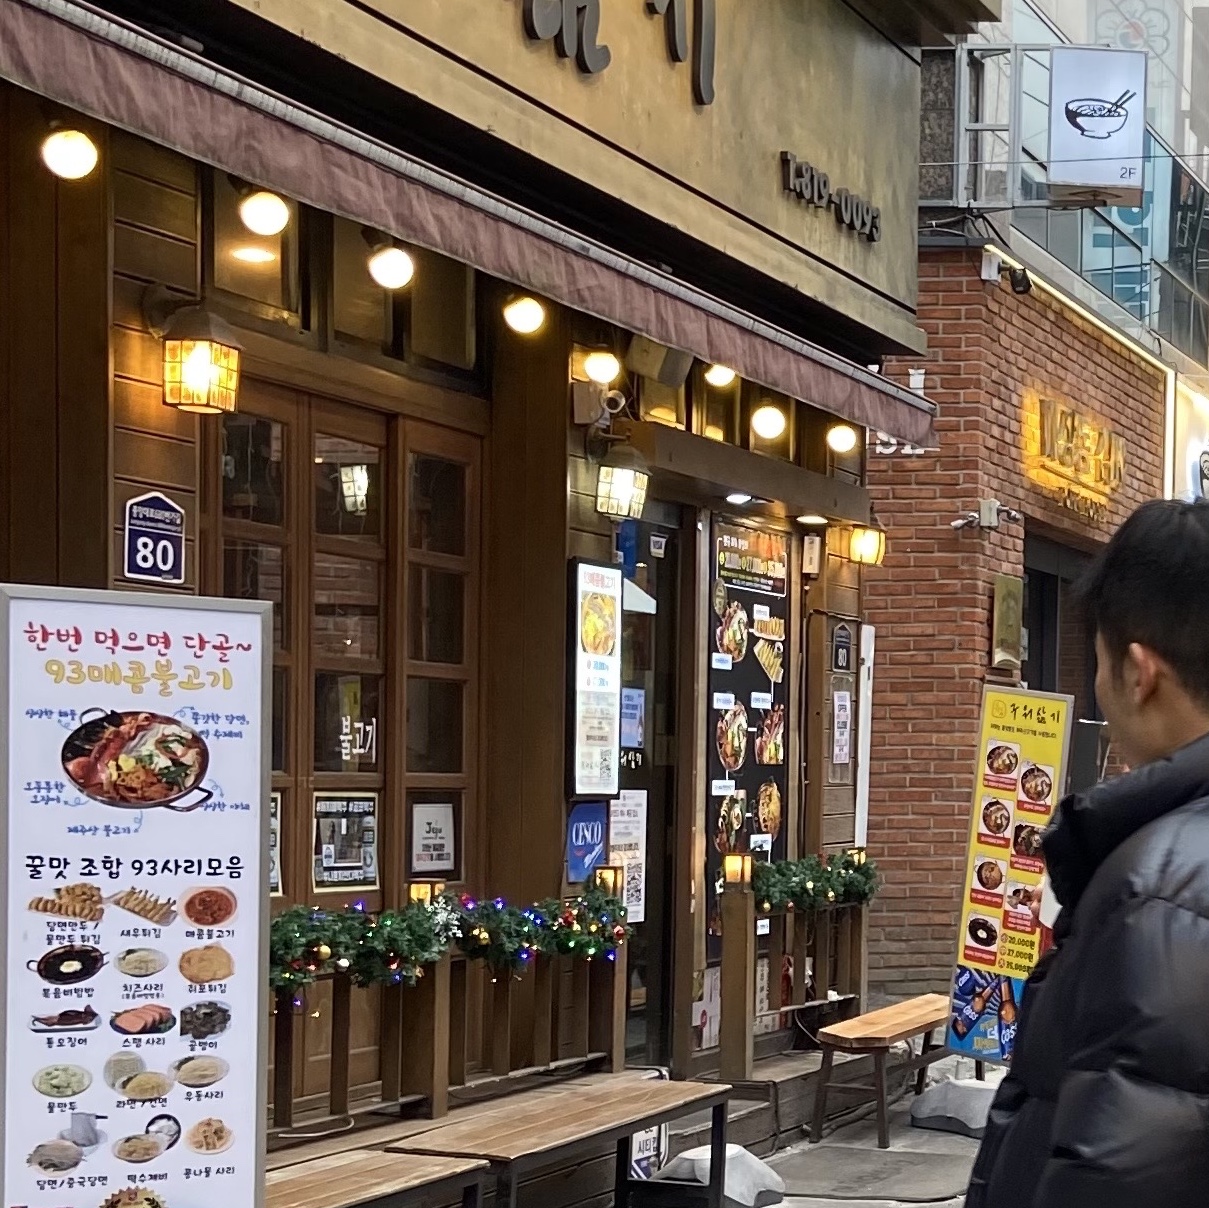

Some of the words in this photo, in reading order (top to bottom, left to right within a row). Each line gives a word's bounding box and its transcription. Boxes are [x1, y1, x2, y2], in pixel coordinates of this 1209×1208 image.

[1119, 166, 1137, 180] 2F
[136, 536, 174, 571] 80
[24, 621, 82, 652] 한번
[95, 628, 172, 657] 먹으면
[45, 658, 234, 697] 93매콤불고기
[340, 715, 377, 764] 불고기
[572, 821, 602, 846] CESCO
[25, 855, 71, 880] 꿀맛
[80, 856, 123, 879] 조합
[131, 855, 245, 879] 93사리모음
[120, 927, 162, 940] 새우튀김
[122, 982, 164, 993] 치즈사리
